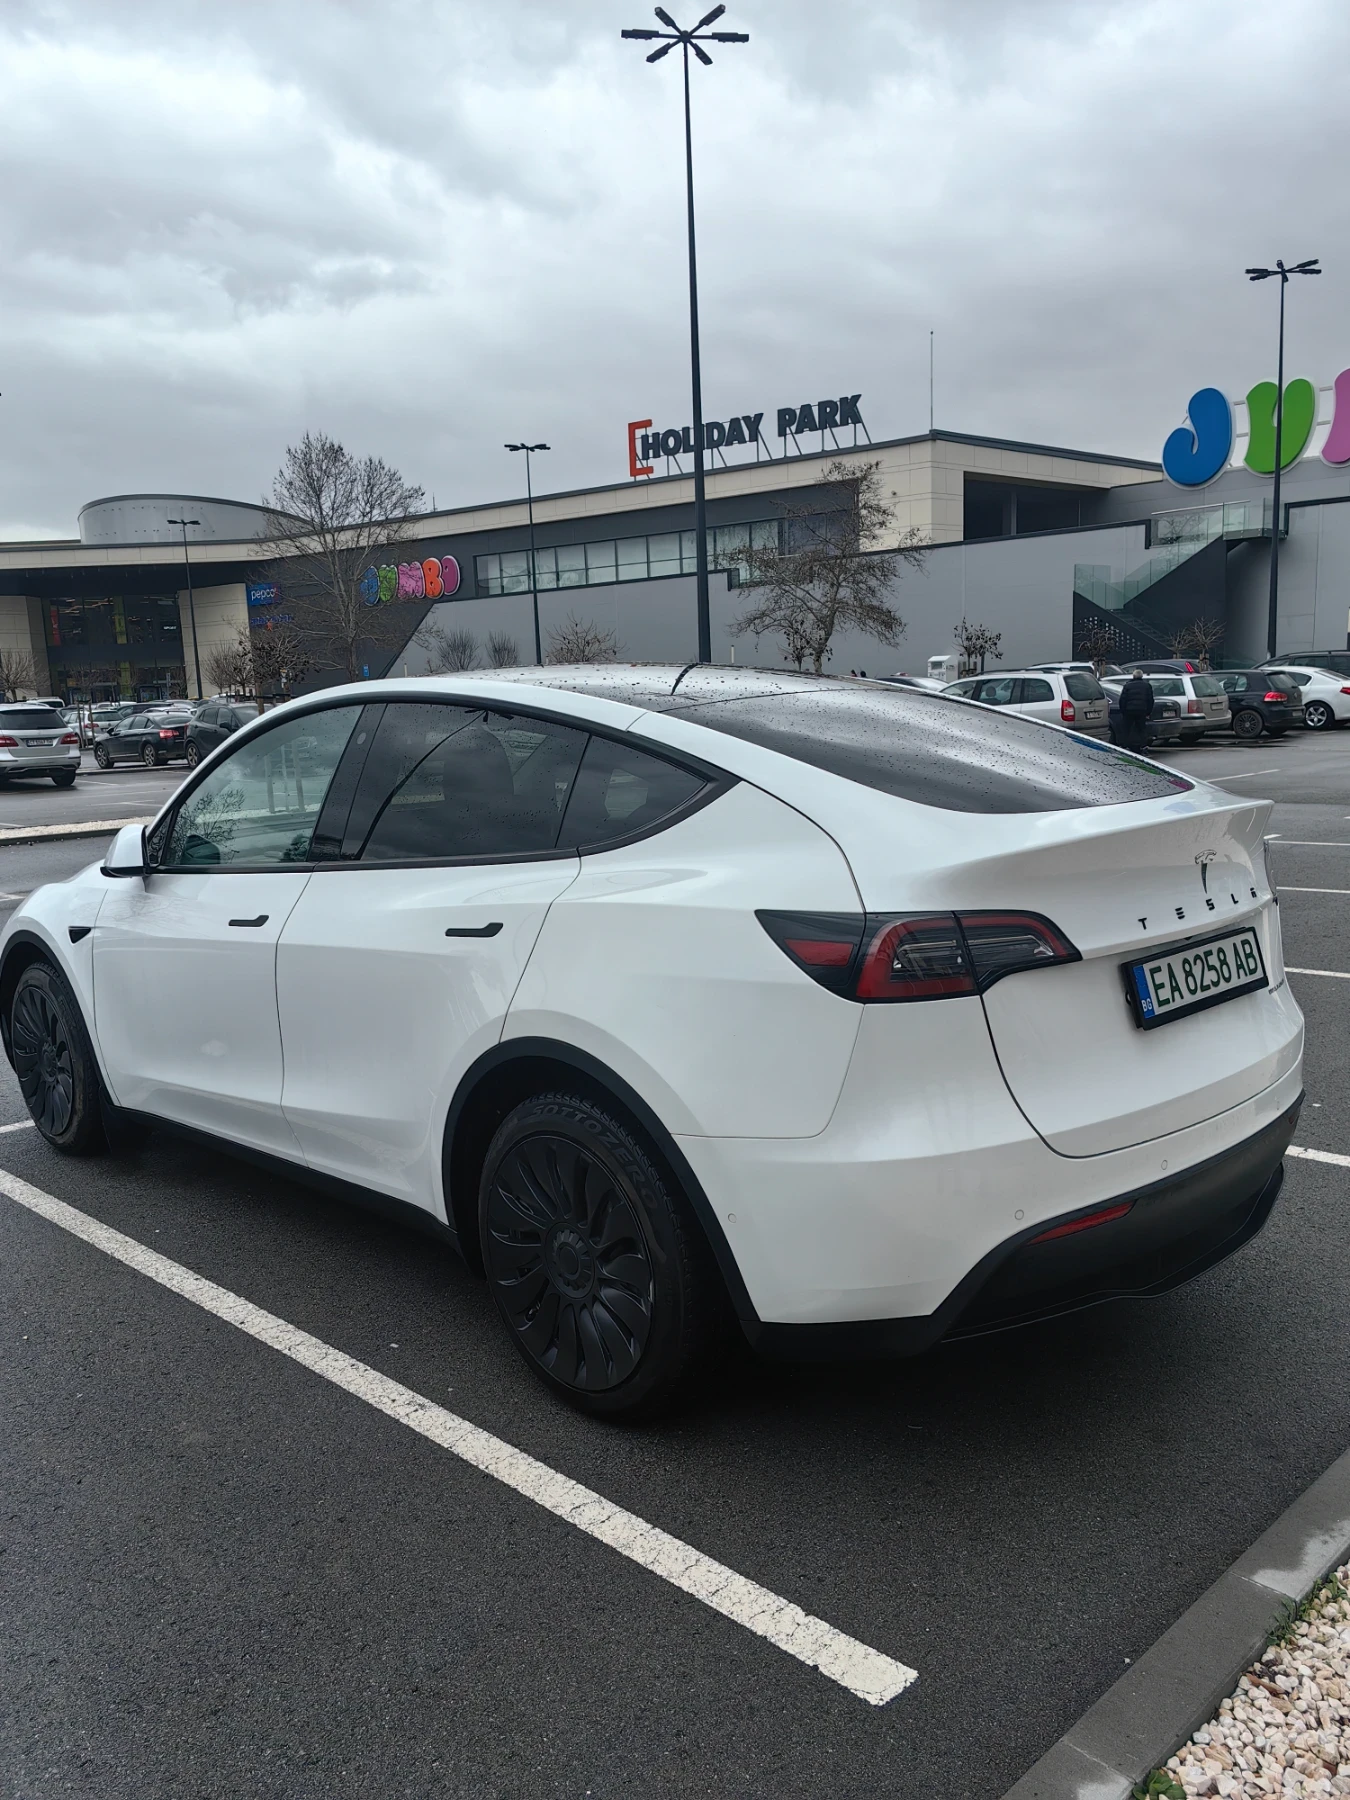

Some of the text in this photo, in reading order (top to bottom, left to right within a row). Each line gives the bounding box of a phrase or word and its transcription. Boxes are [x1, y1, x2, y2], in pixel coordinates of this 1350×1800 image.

[777, 394, 862, 437] PARK
[359, 555, 461, 607] JUMBO
[1137, 887, 1257, 930] TESLA
[1149, 938, 1258, 1008] EA 8258 AB
[1141, 998, 1153, 1012] BG
